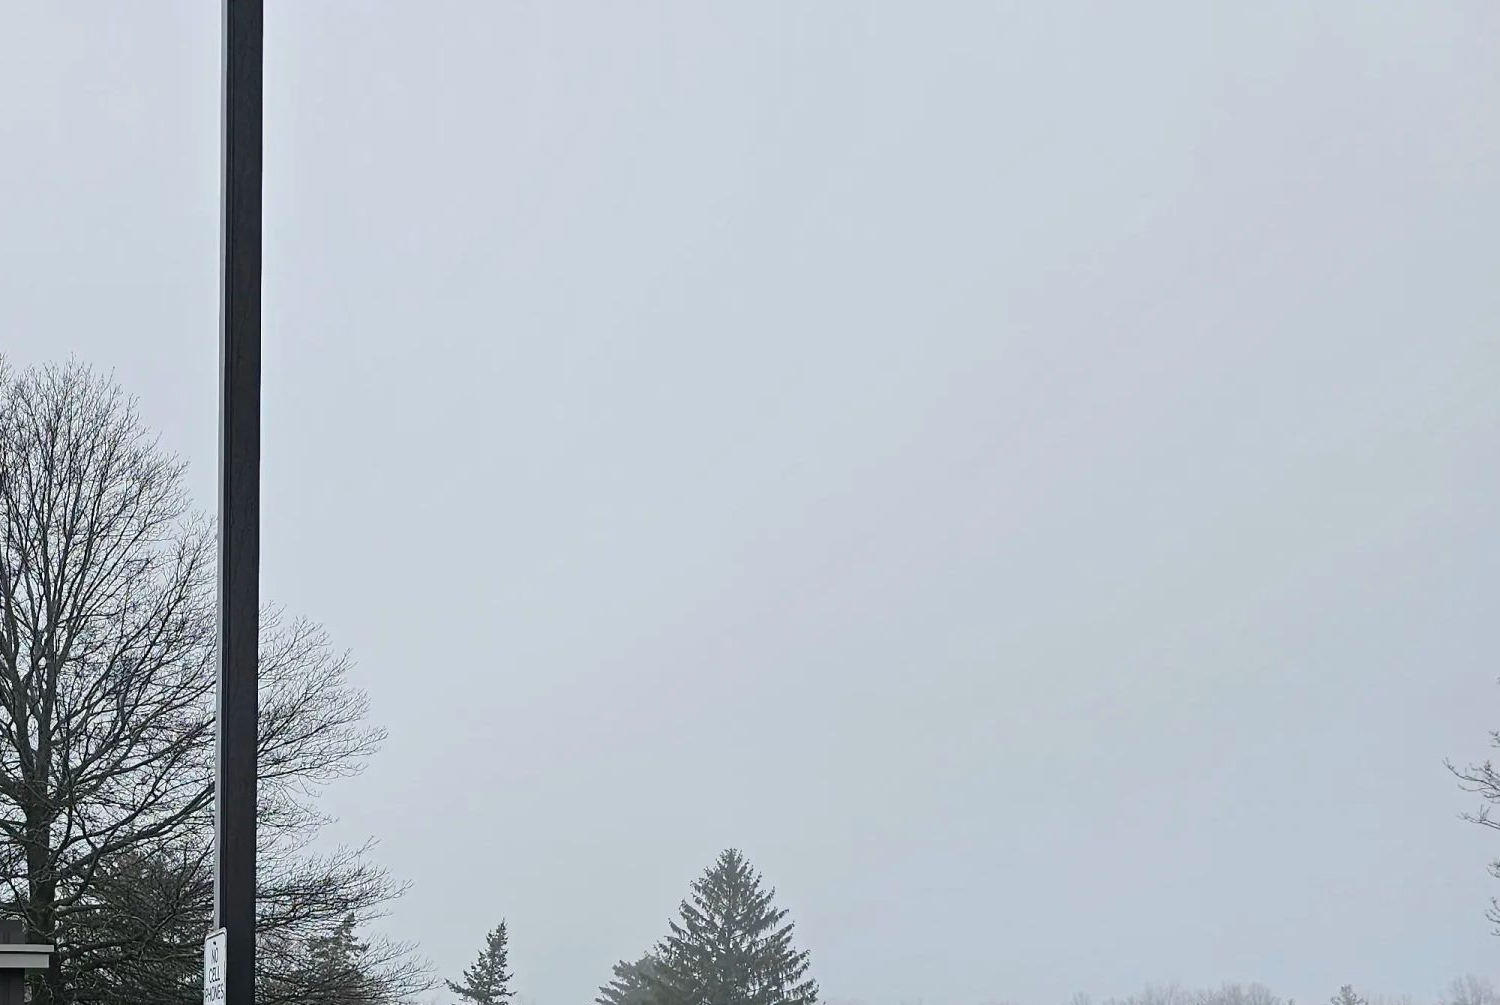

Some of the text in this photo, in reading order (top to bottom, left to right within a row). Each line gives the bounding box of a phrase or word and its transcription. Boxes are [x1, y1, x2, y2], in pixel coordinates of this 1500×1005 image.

[211, 947, 218, 963] NO
[208, 965, 220, 983] CELL
[205, 983, 224, 1002] PHONES
